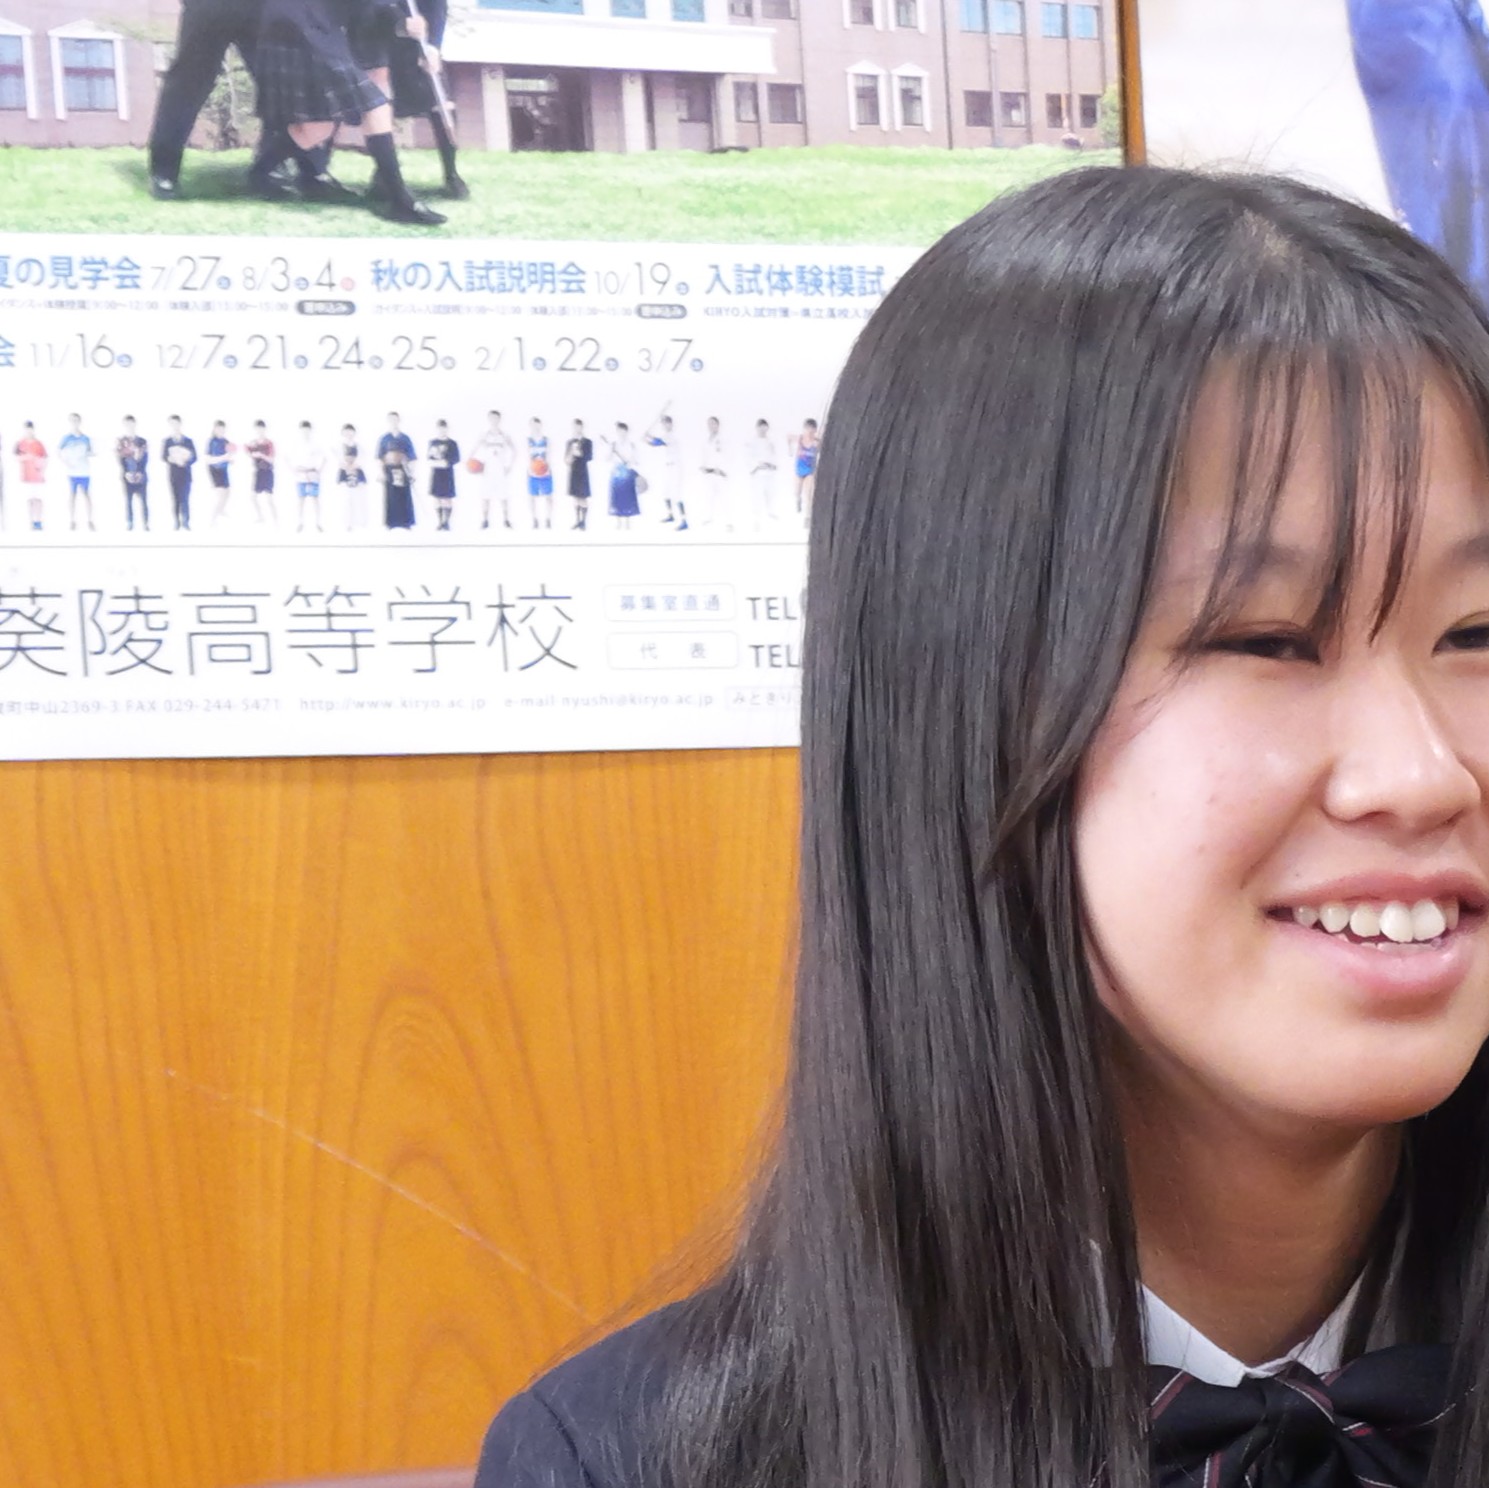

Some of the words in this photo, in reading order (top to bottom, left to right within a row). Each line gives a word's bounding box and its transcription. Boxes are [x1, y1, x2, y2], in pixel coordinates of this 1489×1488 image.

[369, 257, 587, 296] 秋の入試説明会
[704, 262, 886, 299] 入試体験模試
[746, 596, 798, 621] TEL
[0, 583, 579, 679] 葵陵高等学校
[748, 644, 800, 669] TEL
